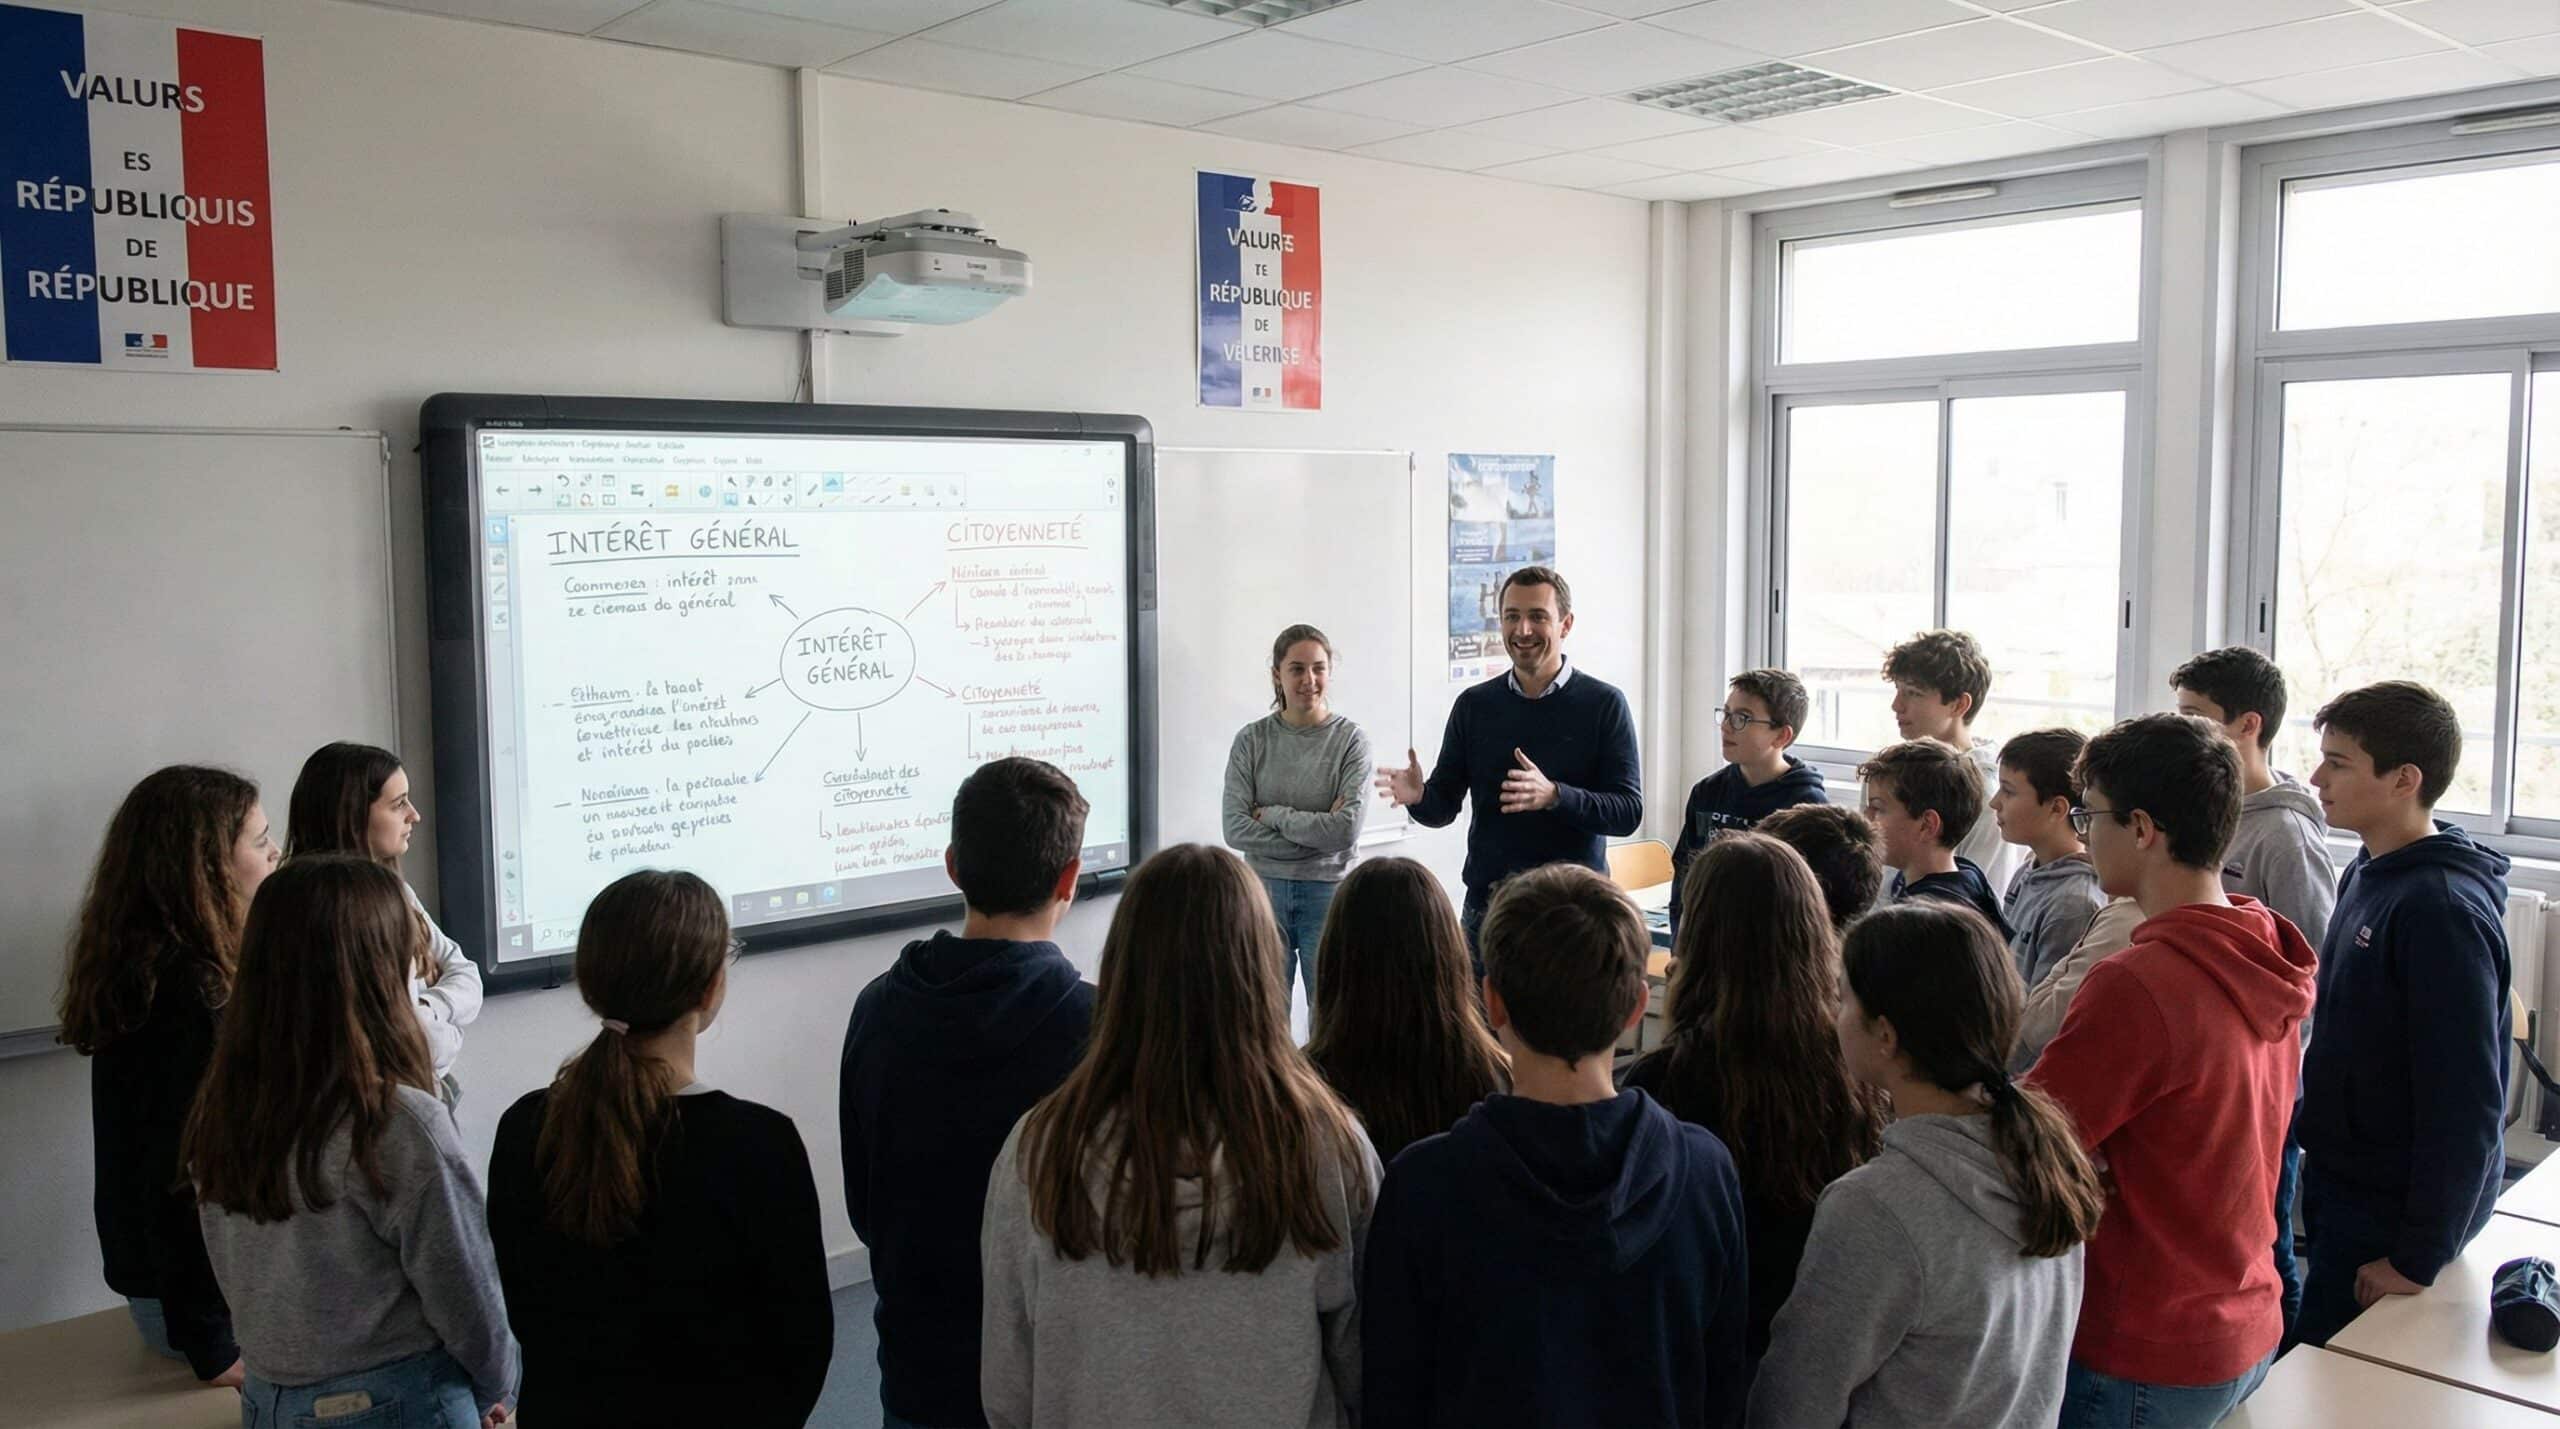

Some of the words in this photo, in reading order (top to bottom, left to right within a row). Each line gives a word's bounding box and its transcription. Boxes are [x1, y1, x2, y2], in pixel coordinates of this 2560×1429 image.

[60, 70, 205, 113] VALURS
[124, 152, 151, 171] ES
[16, 176, 256, 227] RÉPUBLIQUIS
[126, 238, 157, 258] DE
[28, 265, 255, 312] RÉPUBLIQUE
[1210, 280, 1313, 309] RÉPUBLIQUE
[1255, 318, 1269, 332] DE
[547, 520, 672, 555] INTÉRÊT
[690, 519, 799, 550] GÉNÉRAL
[679, 591, 737, 618] général
[798, 626, 888, 656] INTÉRÊT
[808, 655, 894, 685] GÉNÉRAL
